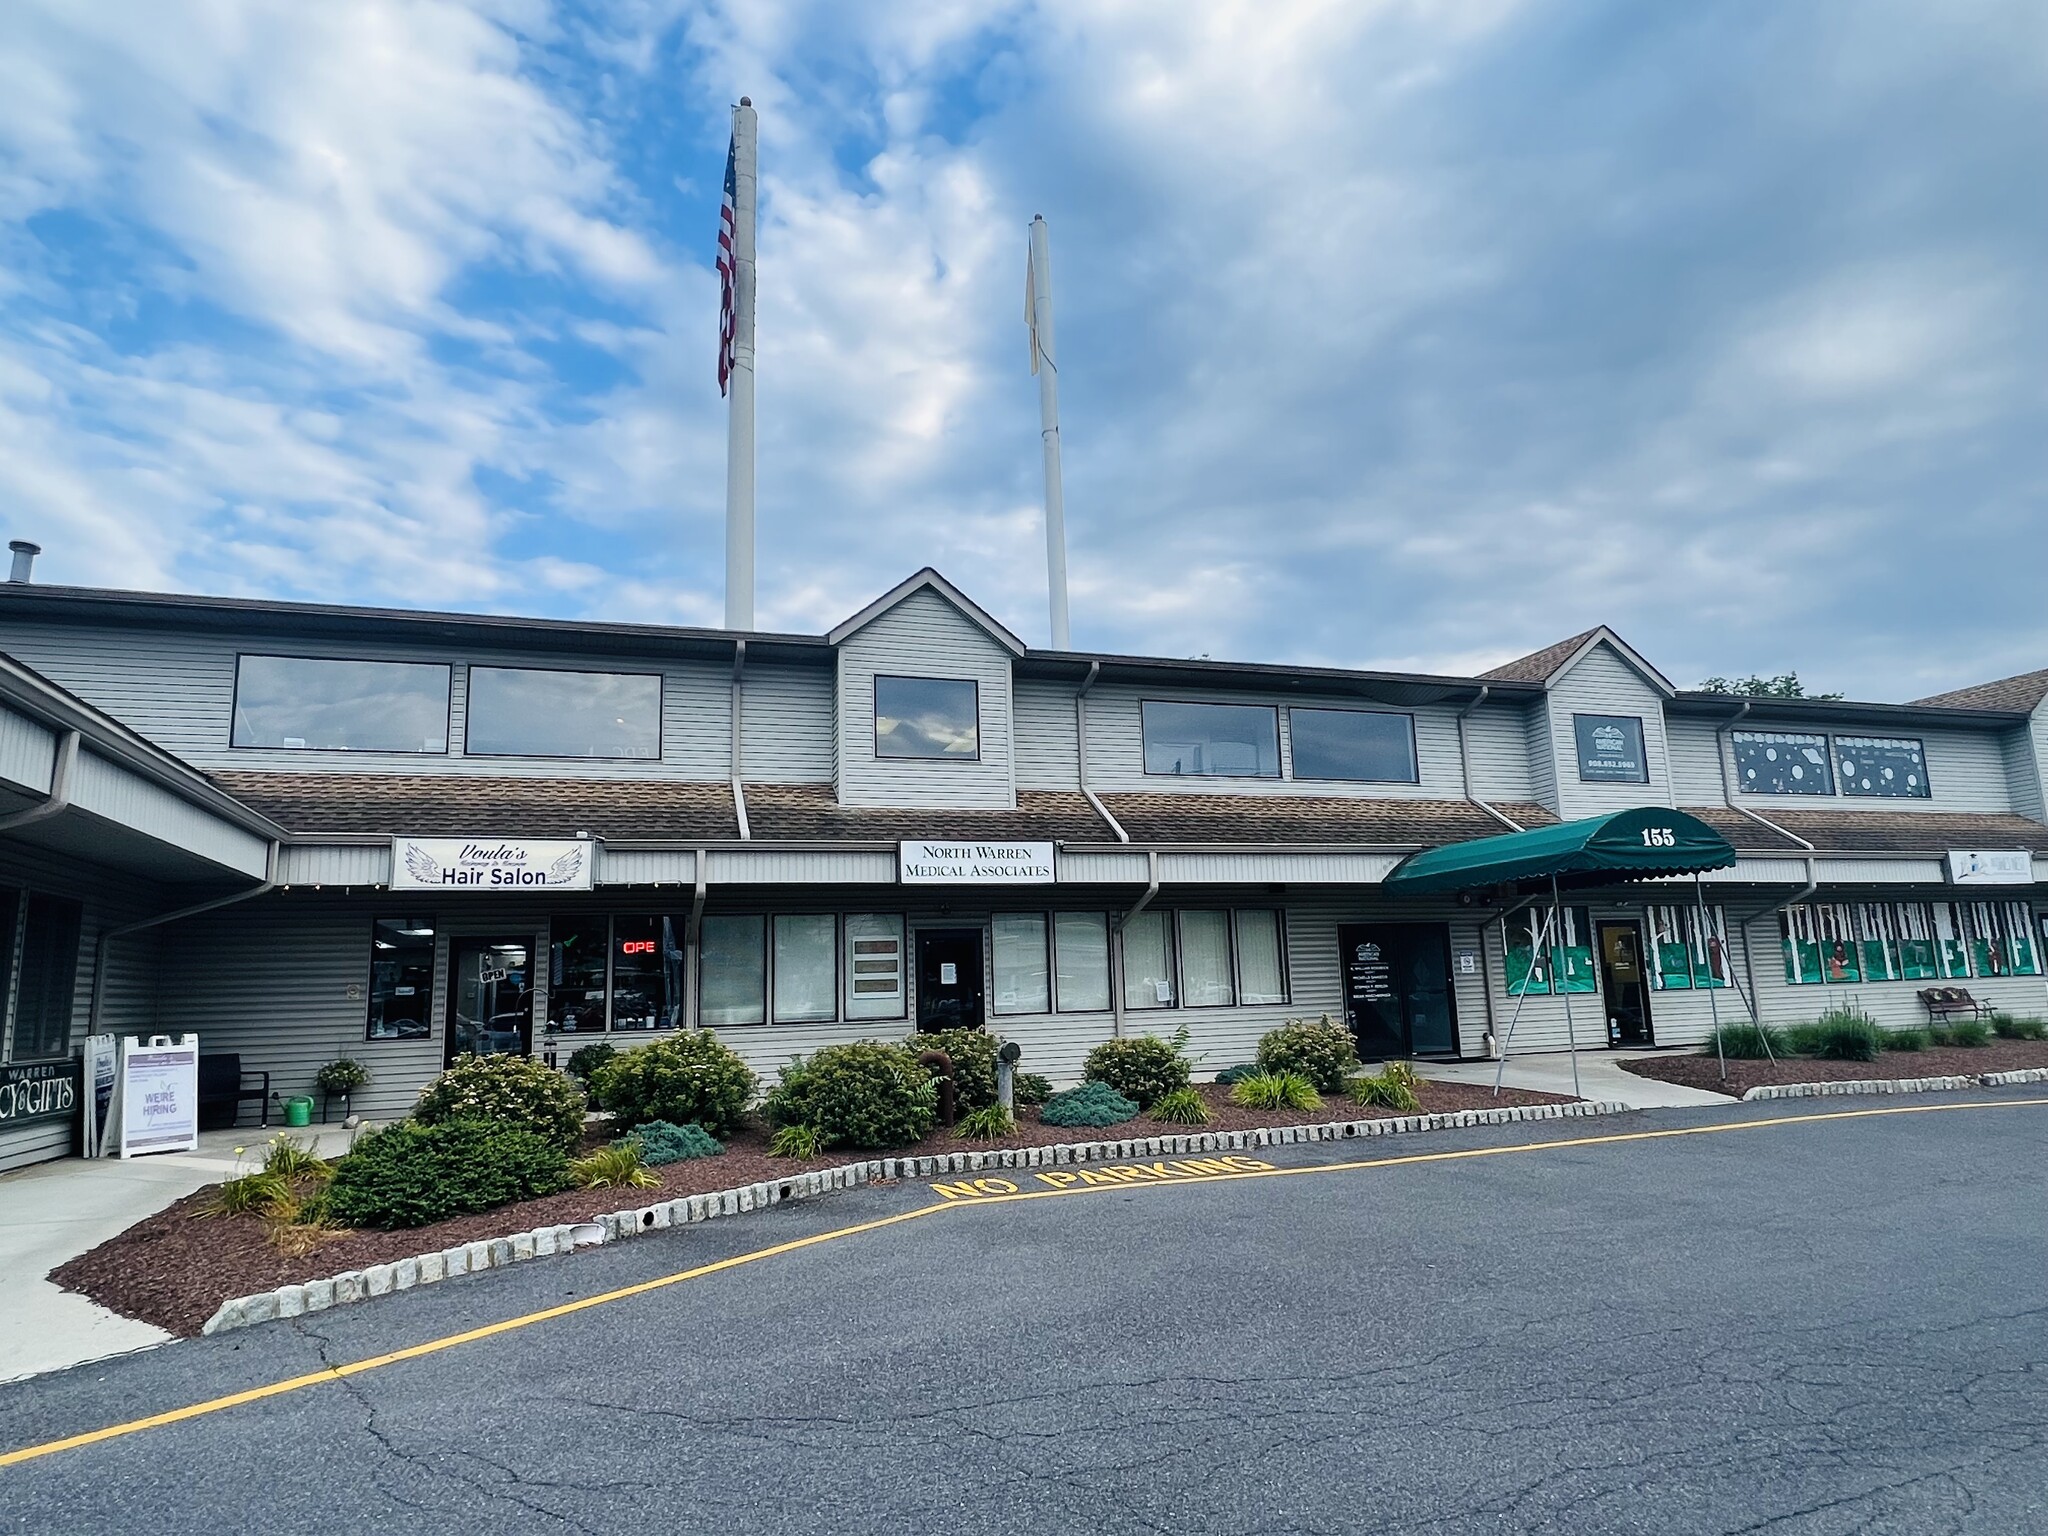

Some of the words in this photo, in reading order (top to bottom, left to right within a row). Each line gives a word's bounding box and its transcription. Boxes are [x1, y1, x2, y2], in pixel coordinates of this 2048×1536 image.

[1641, 828, 1676, 847] 155
[459, 844, 528, 860] Voula's
[922, 846, 971, 859] NORTH
[975, 846, 1032, 860] WARREN
[442, 868, 484, 885] Hair
[490, 868, 547, 885] Salon
[905, 864, 967, 877] MEDICAL
[970, 864, 1050, 877] ASSOCIATES
[623, 941, 656, 954] OPE
[481, 969, 505, 982] OPEN
[143, 1103, 177, 1116] HIRING
[929, 1178, 1019, 1200] NO
[1035, 1155, 1276, 1188] PARKING
